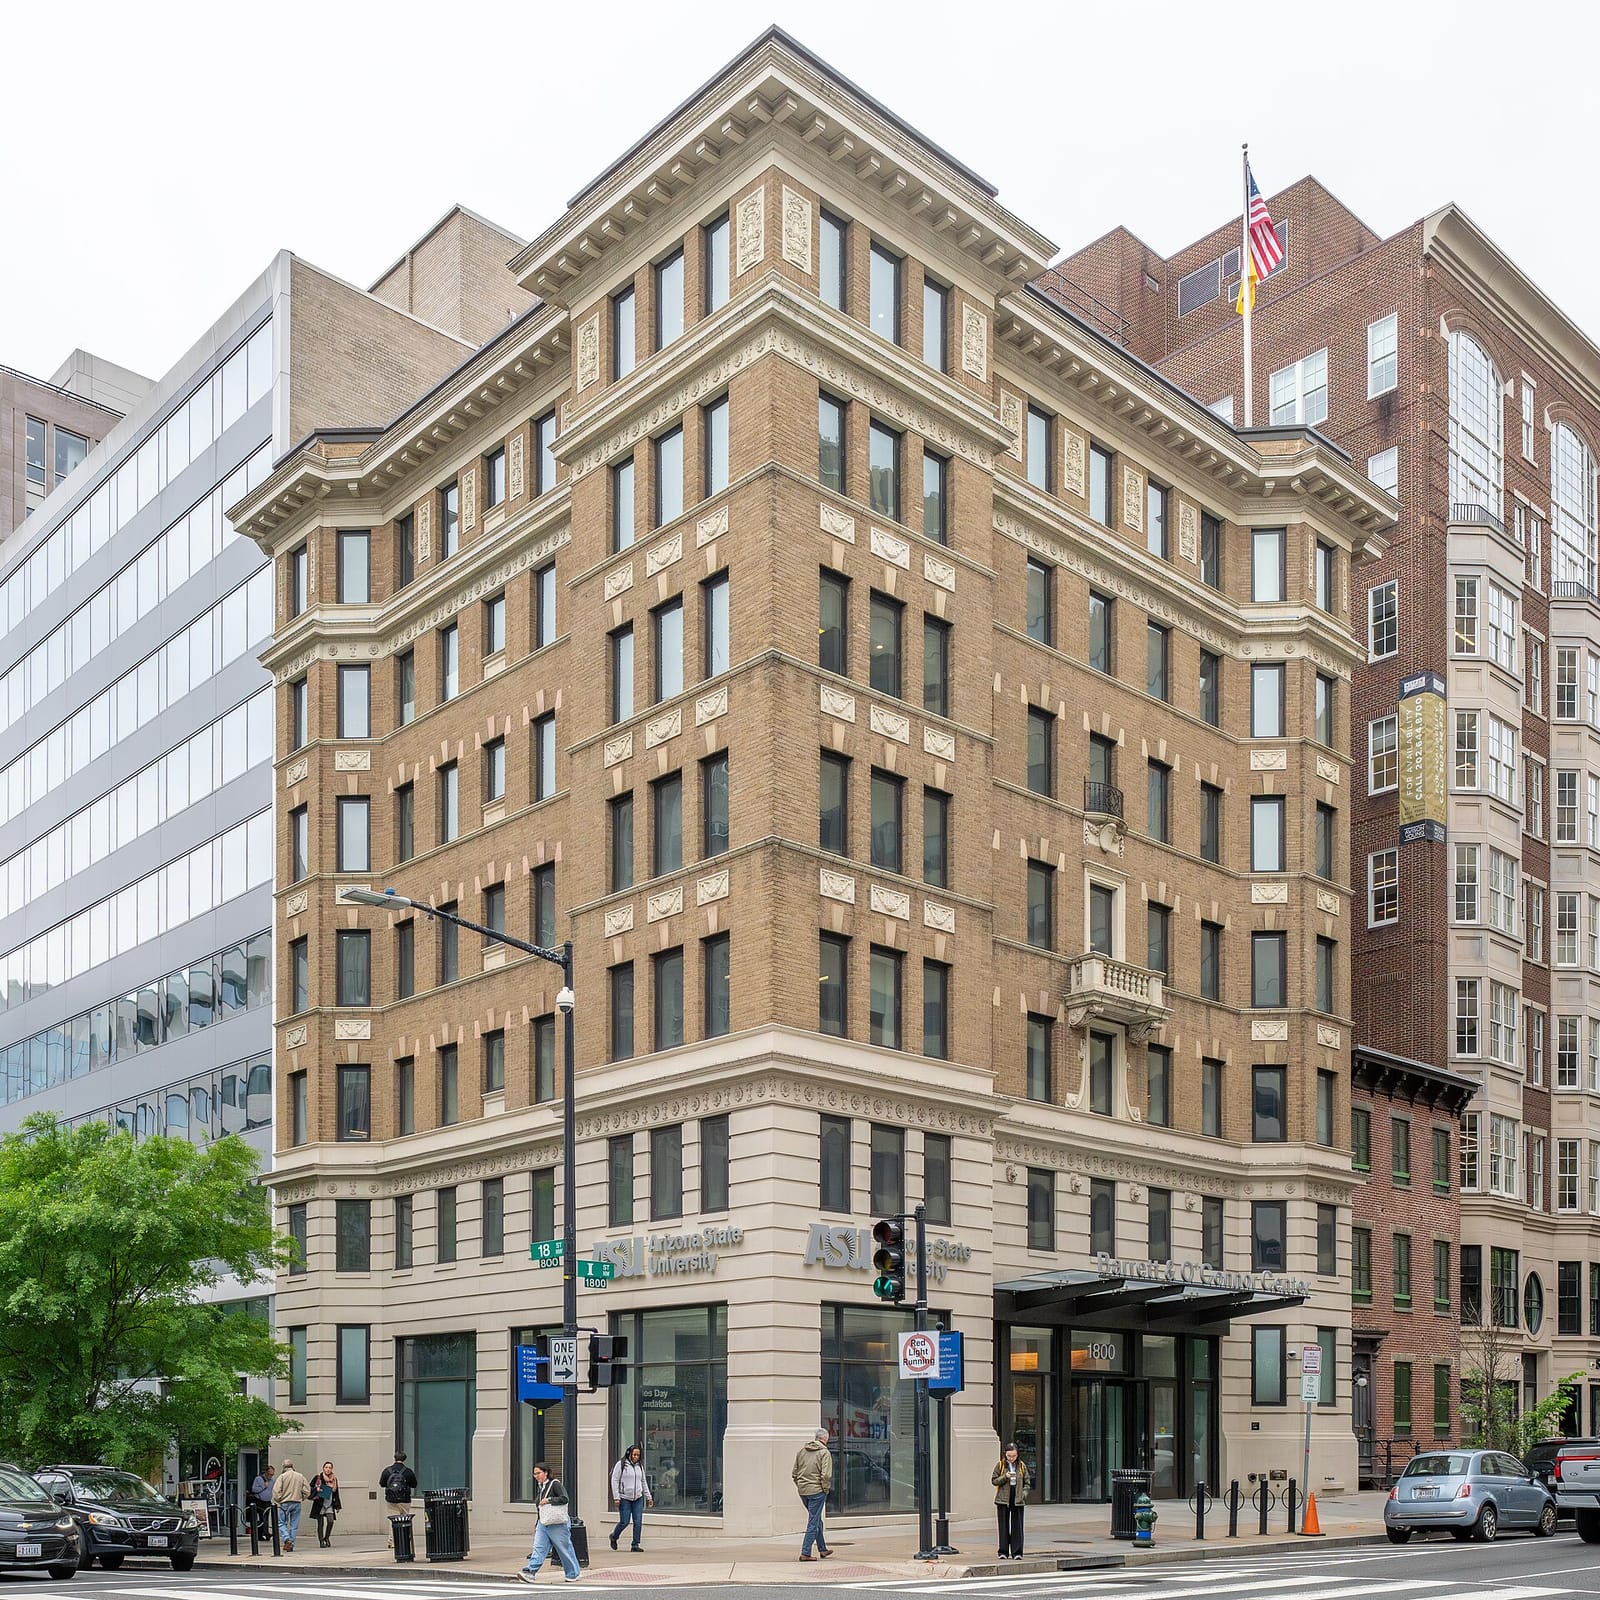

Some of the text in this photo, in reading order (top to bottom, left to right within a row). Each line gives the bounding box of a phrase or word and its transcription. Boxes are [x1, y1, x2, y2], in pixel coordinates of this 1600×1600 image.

[1415, 697, 1423, 801] CALL 202.644.8700
[648, 1225, 744, 1252] Arizona State
[538, 1243, 551, 1257] 18
[806, 1223, 873, 1270] ASU
[935, 1239, 972, 1262] State
[540, 1258, 559, 1268] 800
[587, 1263, 594, 1276] I
[648, 1252, 719, 1275] University
[1096, 1251, 1312, 1295] Barrett & O'Connor Center
[585, 1278, 607, 1288] 1800
[554, 1342, 574, 1353] ONE
[910, 1338, 926, 1347] Red
[909, 1348, 928, 1357] Light
[1088, 1343, 1116, 1360] 1800
[554, 1355, 574, 1366] WAY
[903, 1358, 935, 1366] Running
[654, 1389, 668, 1399] Day
